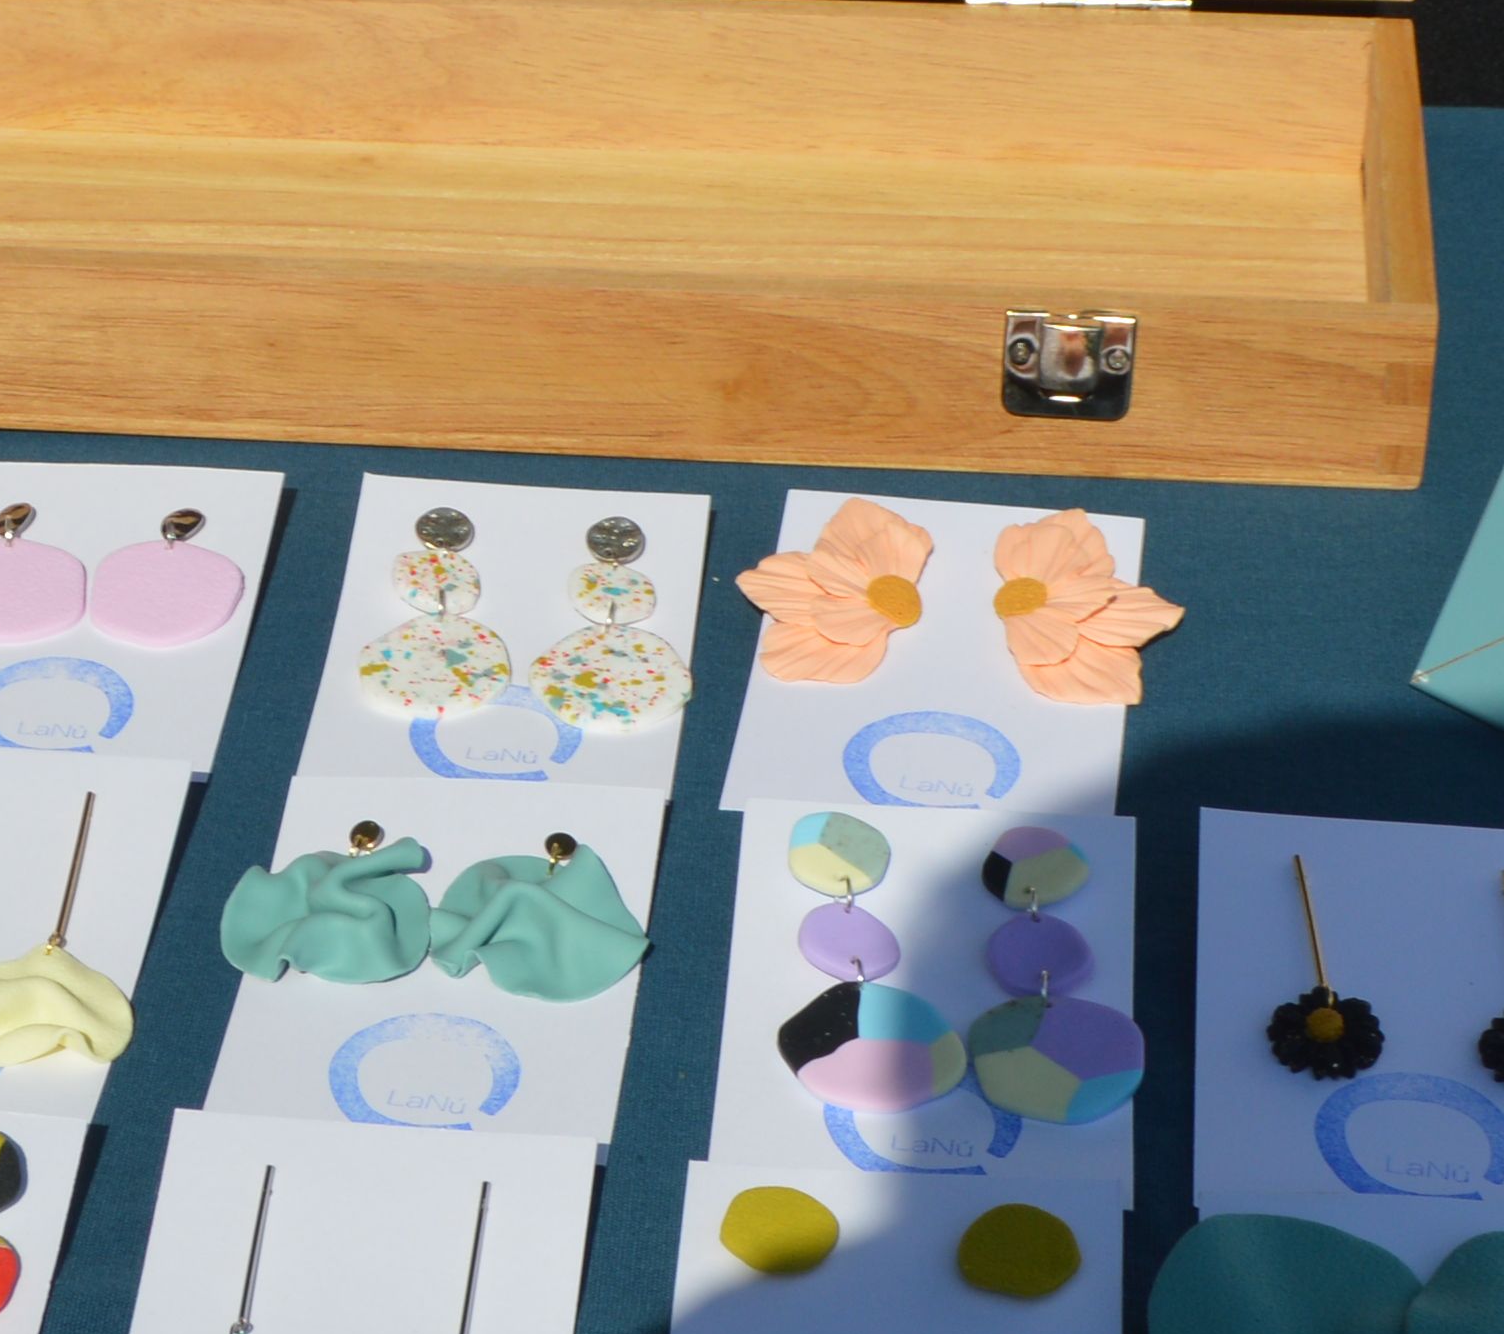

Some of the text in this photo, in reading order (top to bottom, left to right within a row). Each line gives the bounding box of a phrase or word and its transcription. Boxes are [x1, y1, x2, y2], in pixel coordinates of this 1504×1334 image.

[17, 721, 87, 740] LaNú
[465, 746, 538, 764] LaNú
[899, 775, 972, 797] LaNú
[387, 1089, 466, 1114] LaNú
[891, 1132, 973, 1158] LaNú
[1385, 1157, 1469, 1183] LaNú
